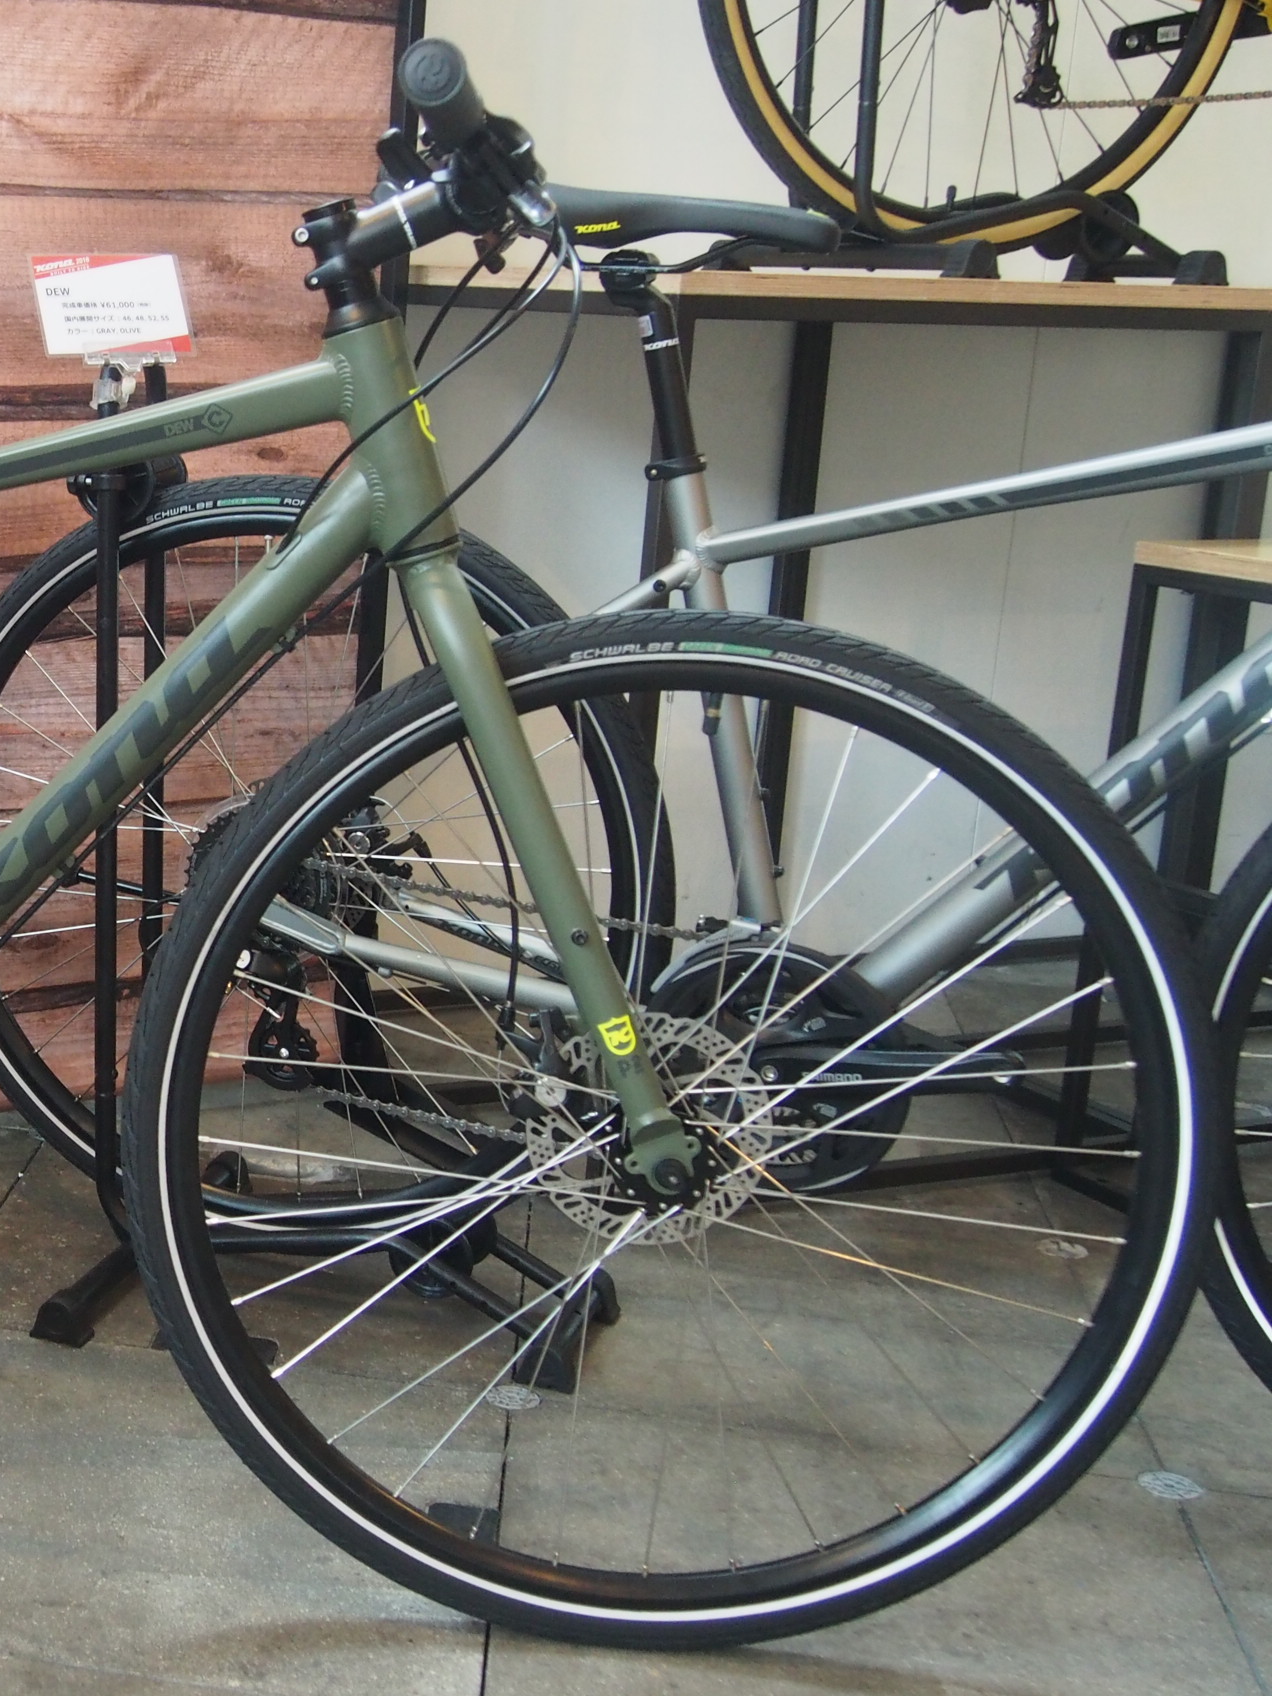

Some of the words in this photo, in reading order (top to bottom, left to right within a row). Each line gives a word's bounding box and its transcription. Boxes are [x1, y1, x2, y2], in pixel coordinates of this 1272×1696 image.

[45, 287, 70, 296] DEW
[145, 500, 214, 525] SCHWALBE
[569, 642, 675, 663] SCHWALBE
[774, 651, 822, 668] ROAD
[825, 663, 893, 693] CRUISER
